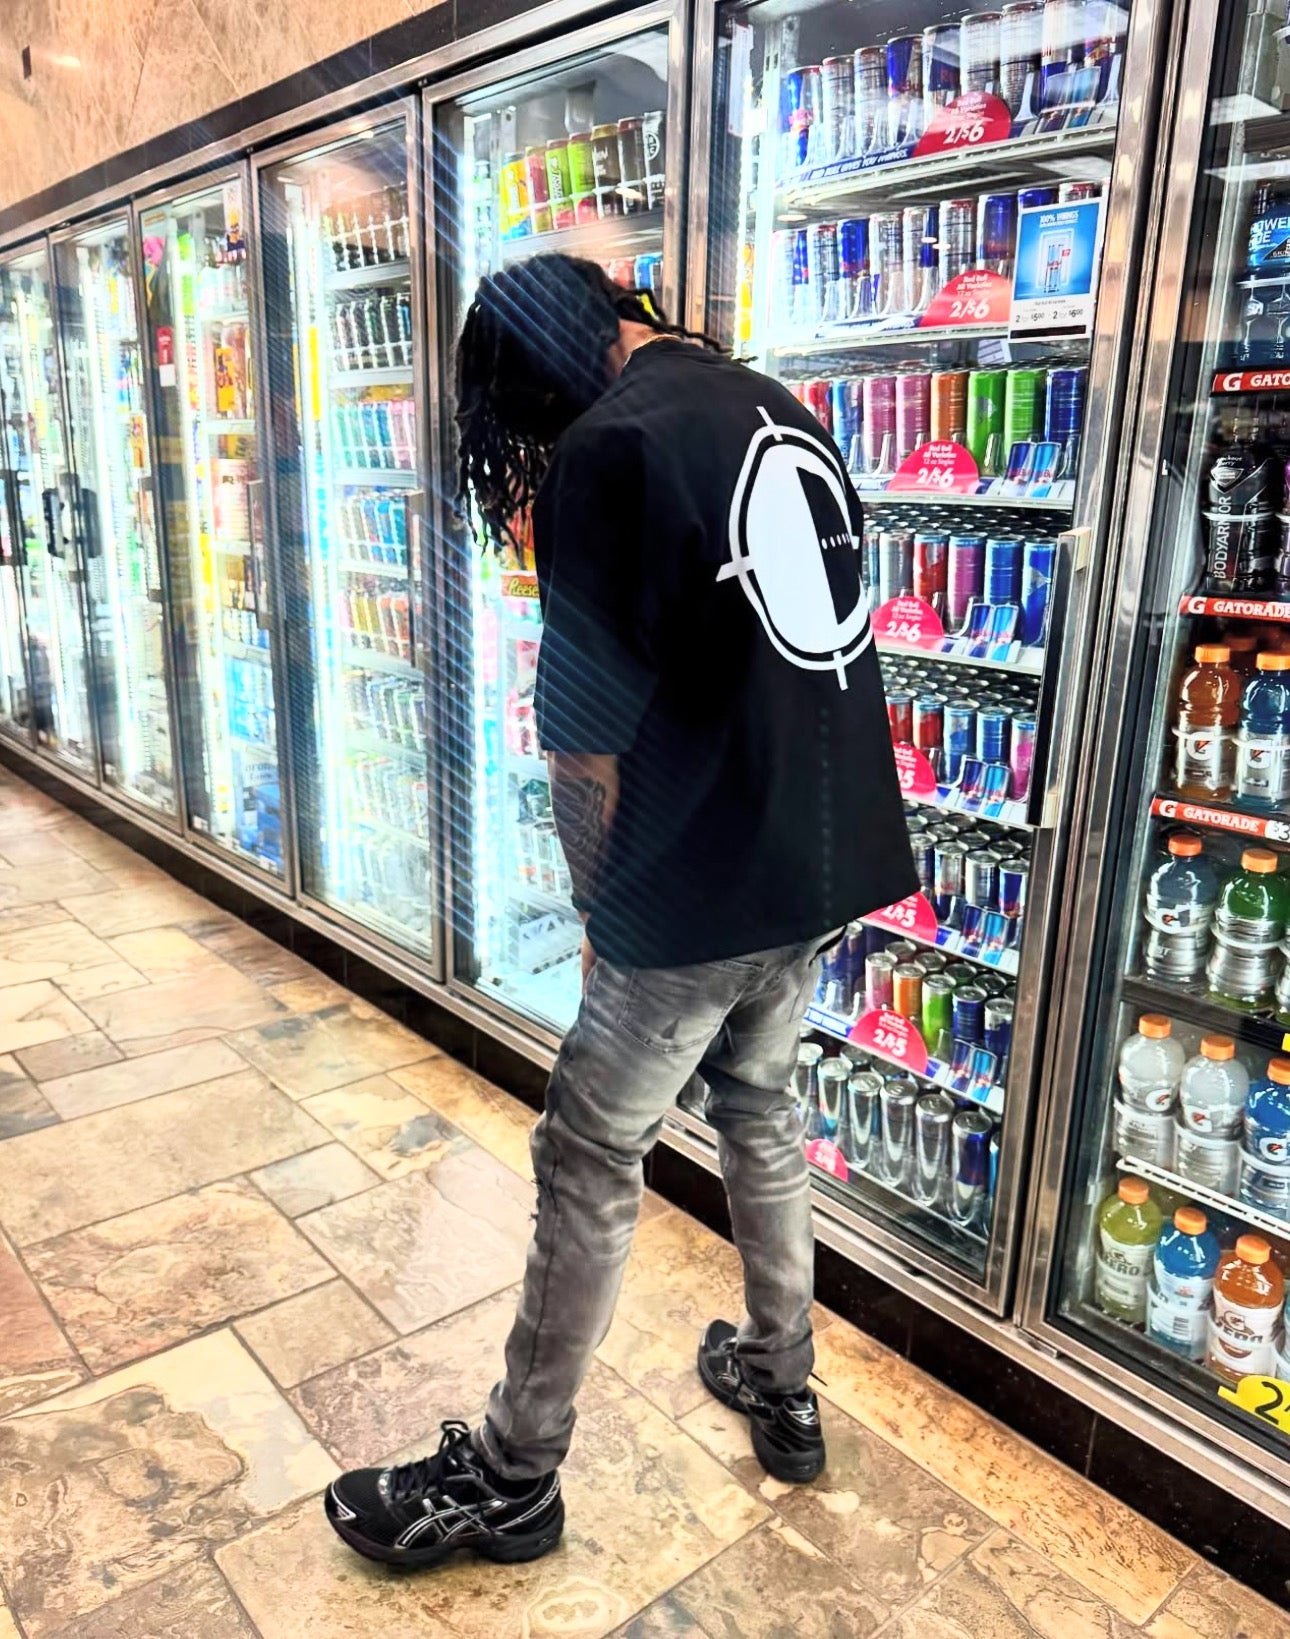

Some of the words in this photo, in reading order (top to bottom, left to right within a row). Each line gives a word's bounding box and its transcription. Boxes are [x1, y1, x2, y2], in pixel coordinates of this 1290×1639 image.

[943, 121, 985, 145] 2/$6
[949, 298, 991, 319] 2/$6
[1223, 373, 1244, 392] G
[923, 451, 931, 459] All
[932, 451, 956, 459] Varieties
[929, 444, 940, 452] Red
[941, 444, 953, 453] Bull
[937, 458, 955, 467] Singles
[916, 466, 955, 489] 2/$6
[1213, 495, 1232, 579] BODYAROR
[1188, 596, 1208, 615] G
[1214, 601, 1290, 620] GATORADE
[886, 620, 922, 643] 2/$6
[1159, 800, 1179, 818] G
[1183, 807, 1260, 833] GATORADE
